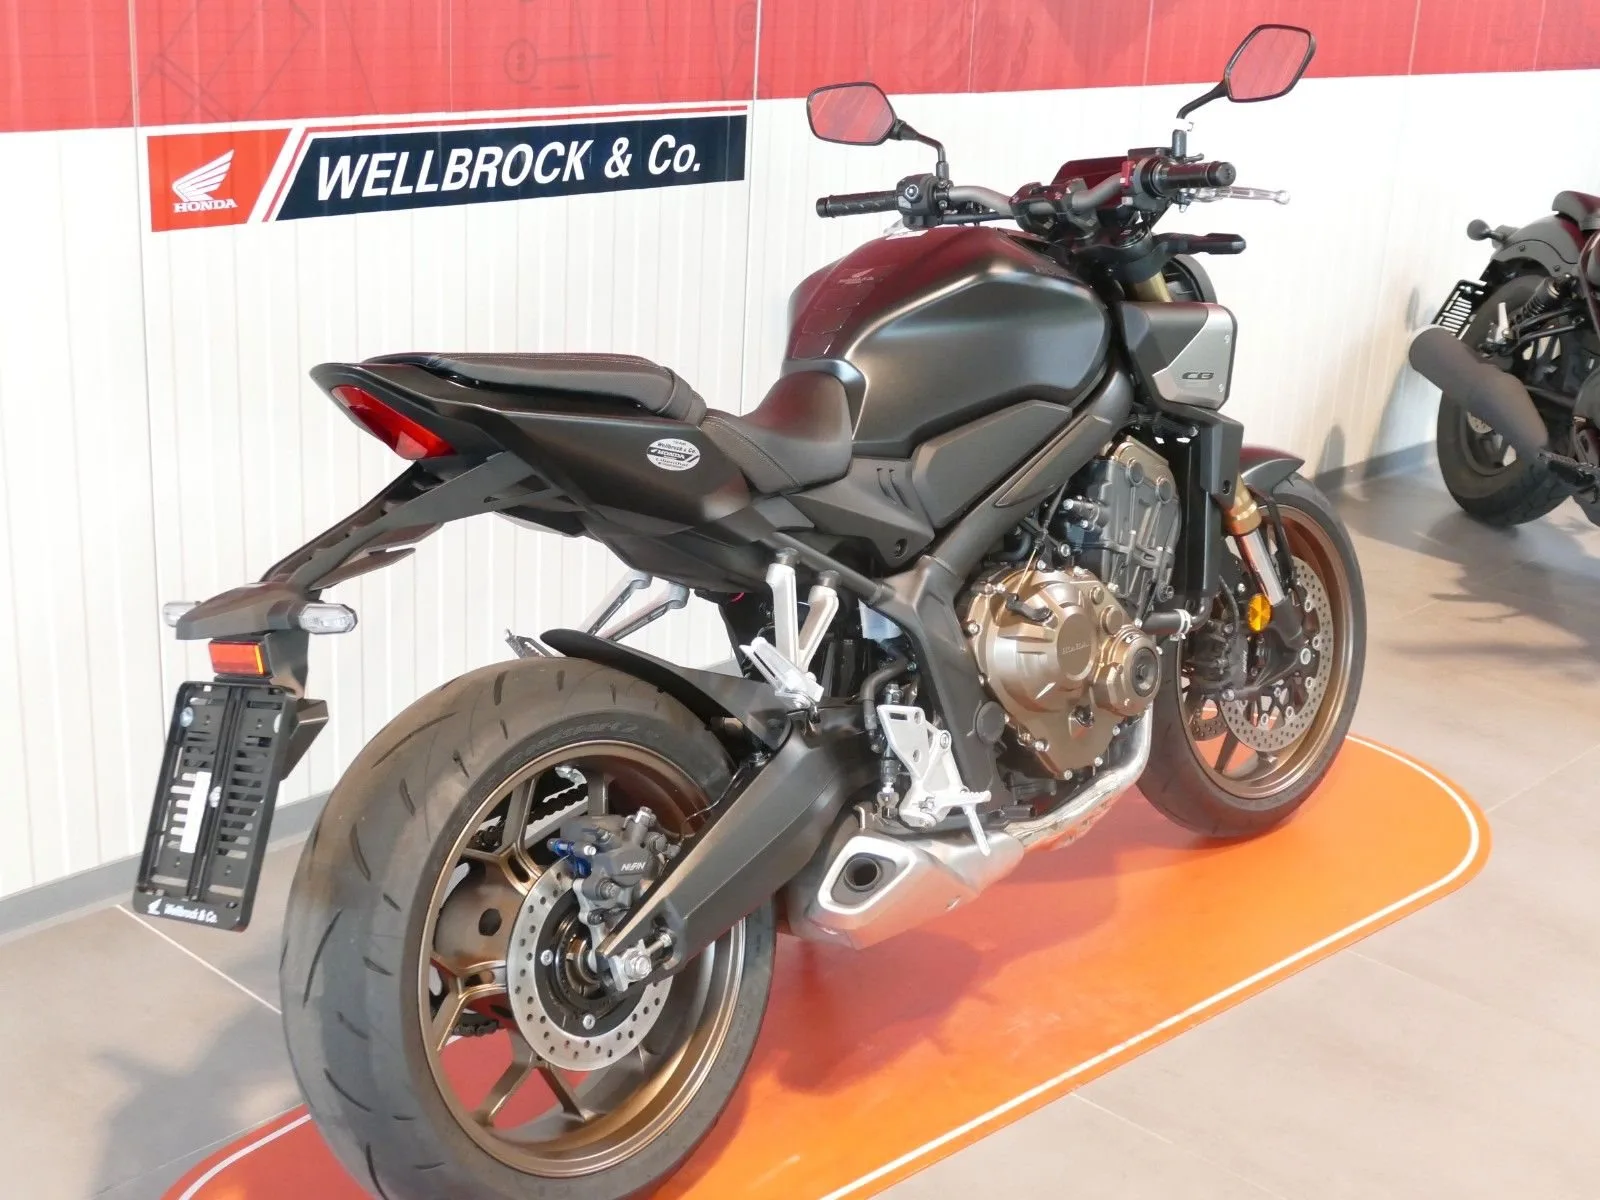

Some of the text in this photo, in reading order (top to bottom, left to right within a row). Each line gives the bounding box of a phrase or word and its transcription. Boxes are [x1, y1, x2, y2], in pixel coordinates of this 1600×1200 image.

[318, 134, 701, 201] WELLBROCK & Co.
[173, 198, 238, 213] HONDA
